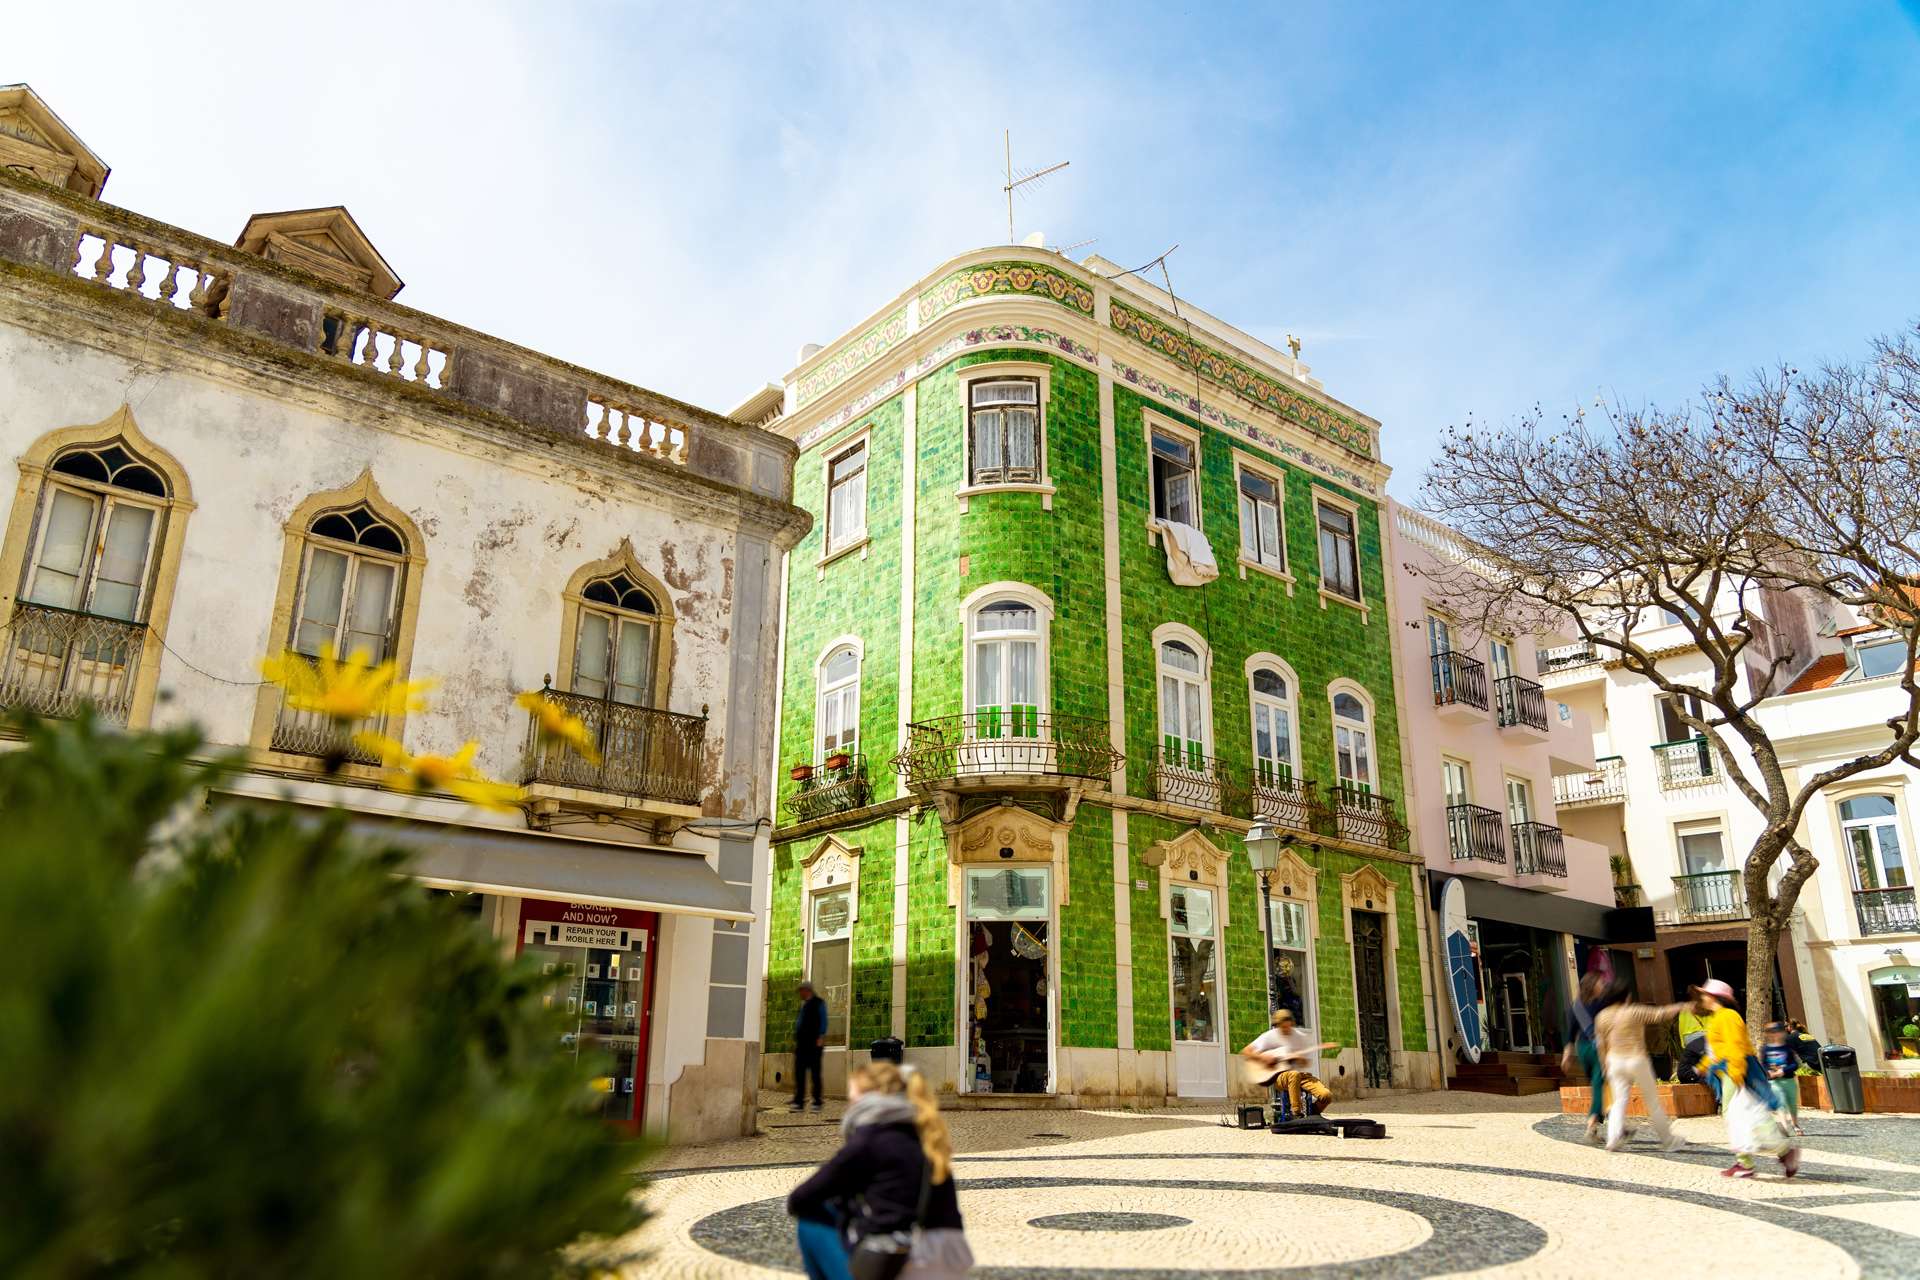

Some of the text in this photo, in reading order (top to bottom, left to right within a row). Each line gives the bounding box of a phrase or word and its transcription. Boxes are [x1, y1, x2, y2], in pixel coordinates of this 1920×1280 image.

[562, 911, 618, 925] AND NOW?
[566, 927, 617, 937] REPAIR YOUR
[565, 935, 616, 946] MOBILE HERE
